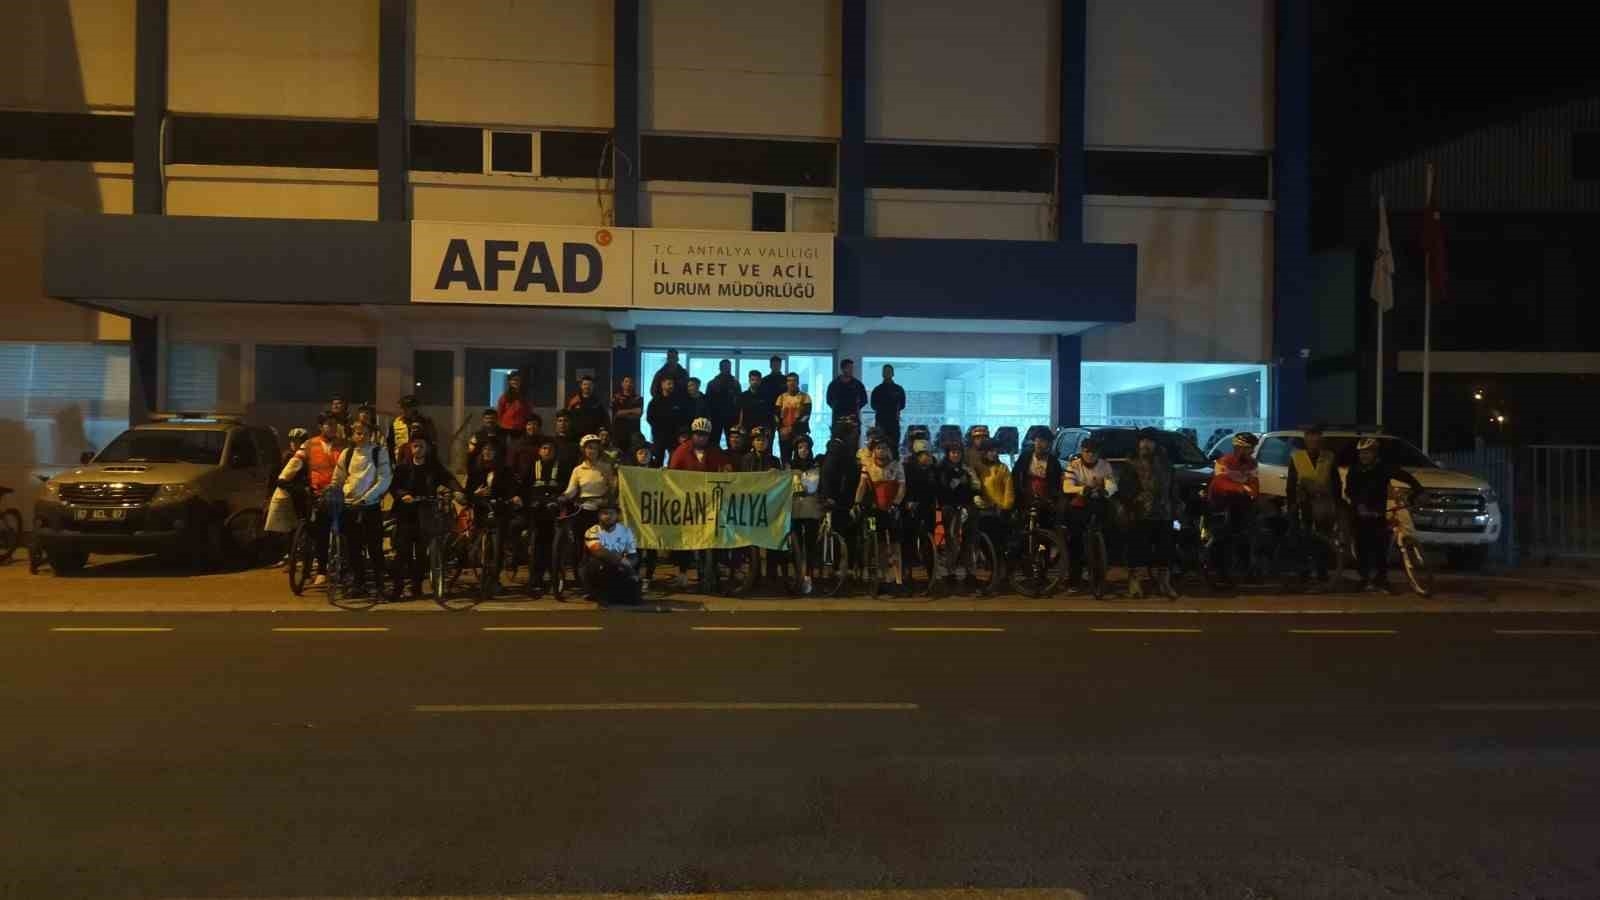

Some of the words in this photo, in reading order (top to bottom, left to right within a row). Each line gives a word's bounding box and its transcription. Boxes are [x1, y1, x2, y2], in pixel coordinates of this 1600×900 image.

[688, 245, 752, 257] ANTALYA
[434, 238, 604, 294] AFAD
[653, 259, 670, 275] İL
[682, 261, 728, 277] AFET
[738, 263, 761, 278] VE
[773, 262, 814, 279] ACİL
[653, 281, 711, 296] DURUM
[718, 281, 815, 299] MÜDÜRLÜĞÜ
